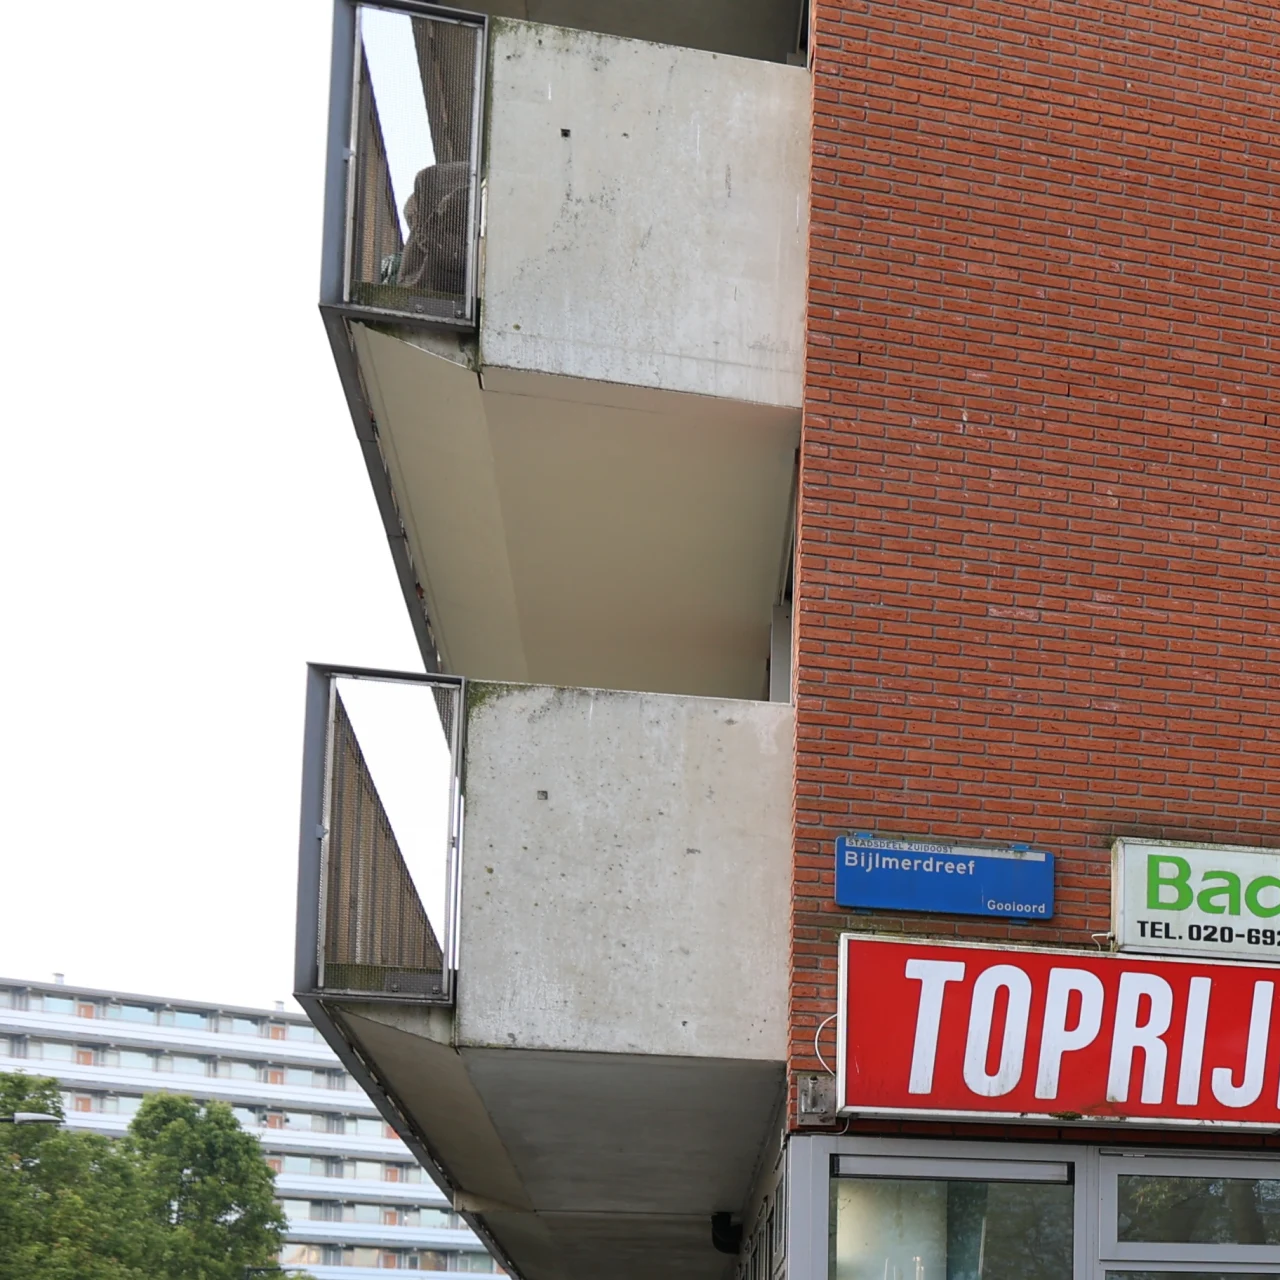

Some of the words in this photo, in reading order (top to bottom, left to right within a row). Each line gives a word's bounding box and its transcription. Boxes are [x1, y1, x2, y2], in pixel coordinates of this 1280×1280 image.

[848, 838, 904, 851] STADSDEEL
[907, 843, 954, 854] ZUIDOOST
[844, 851, 975, 876] Bijlmerdreef
[987, 899, 1046, 914] Gooioord
[1137, 920, 1183, 941] TEL.
